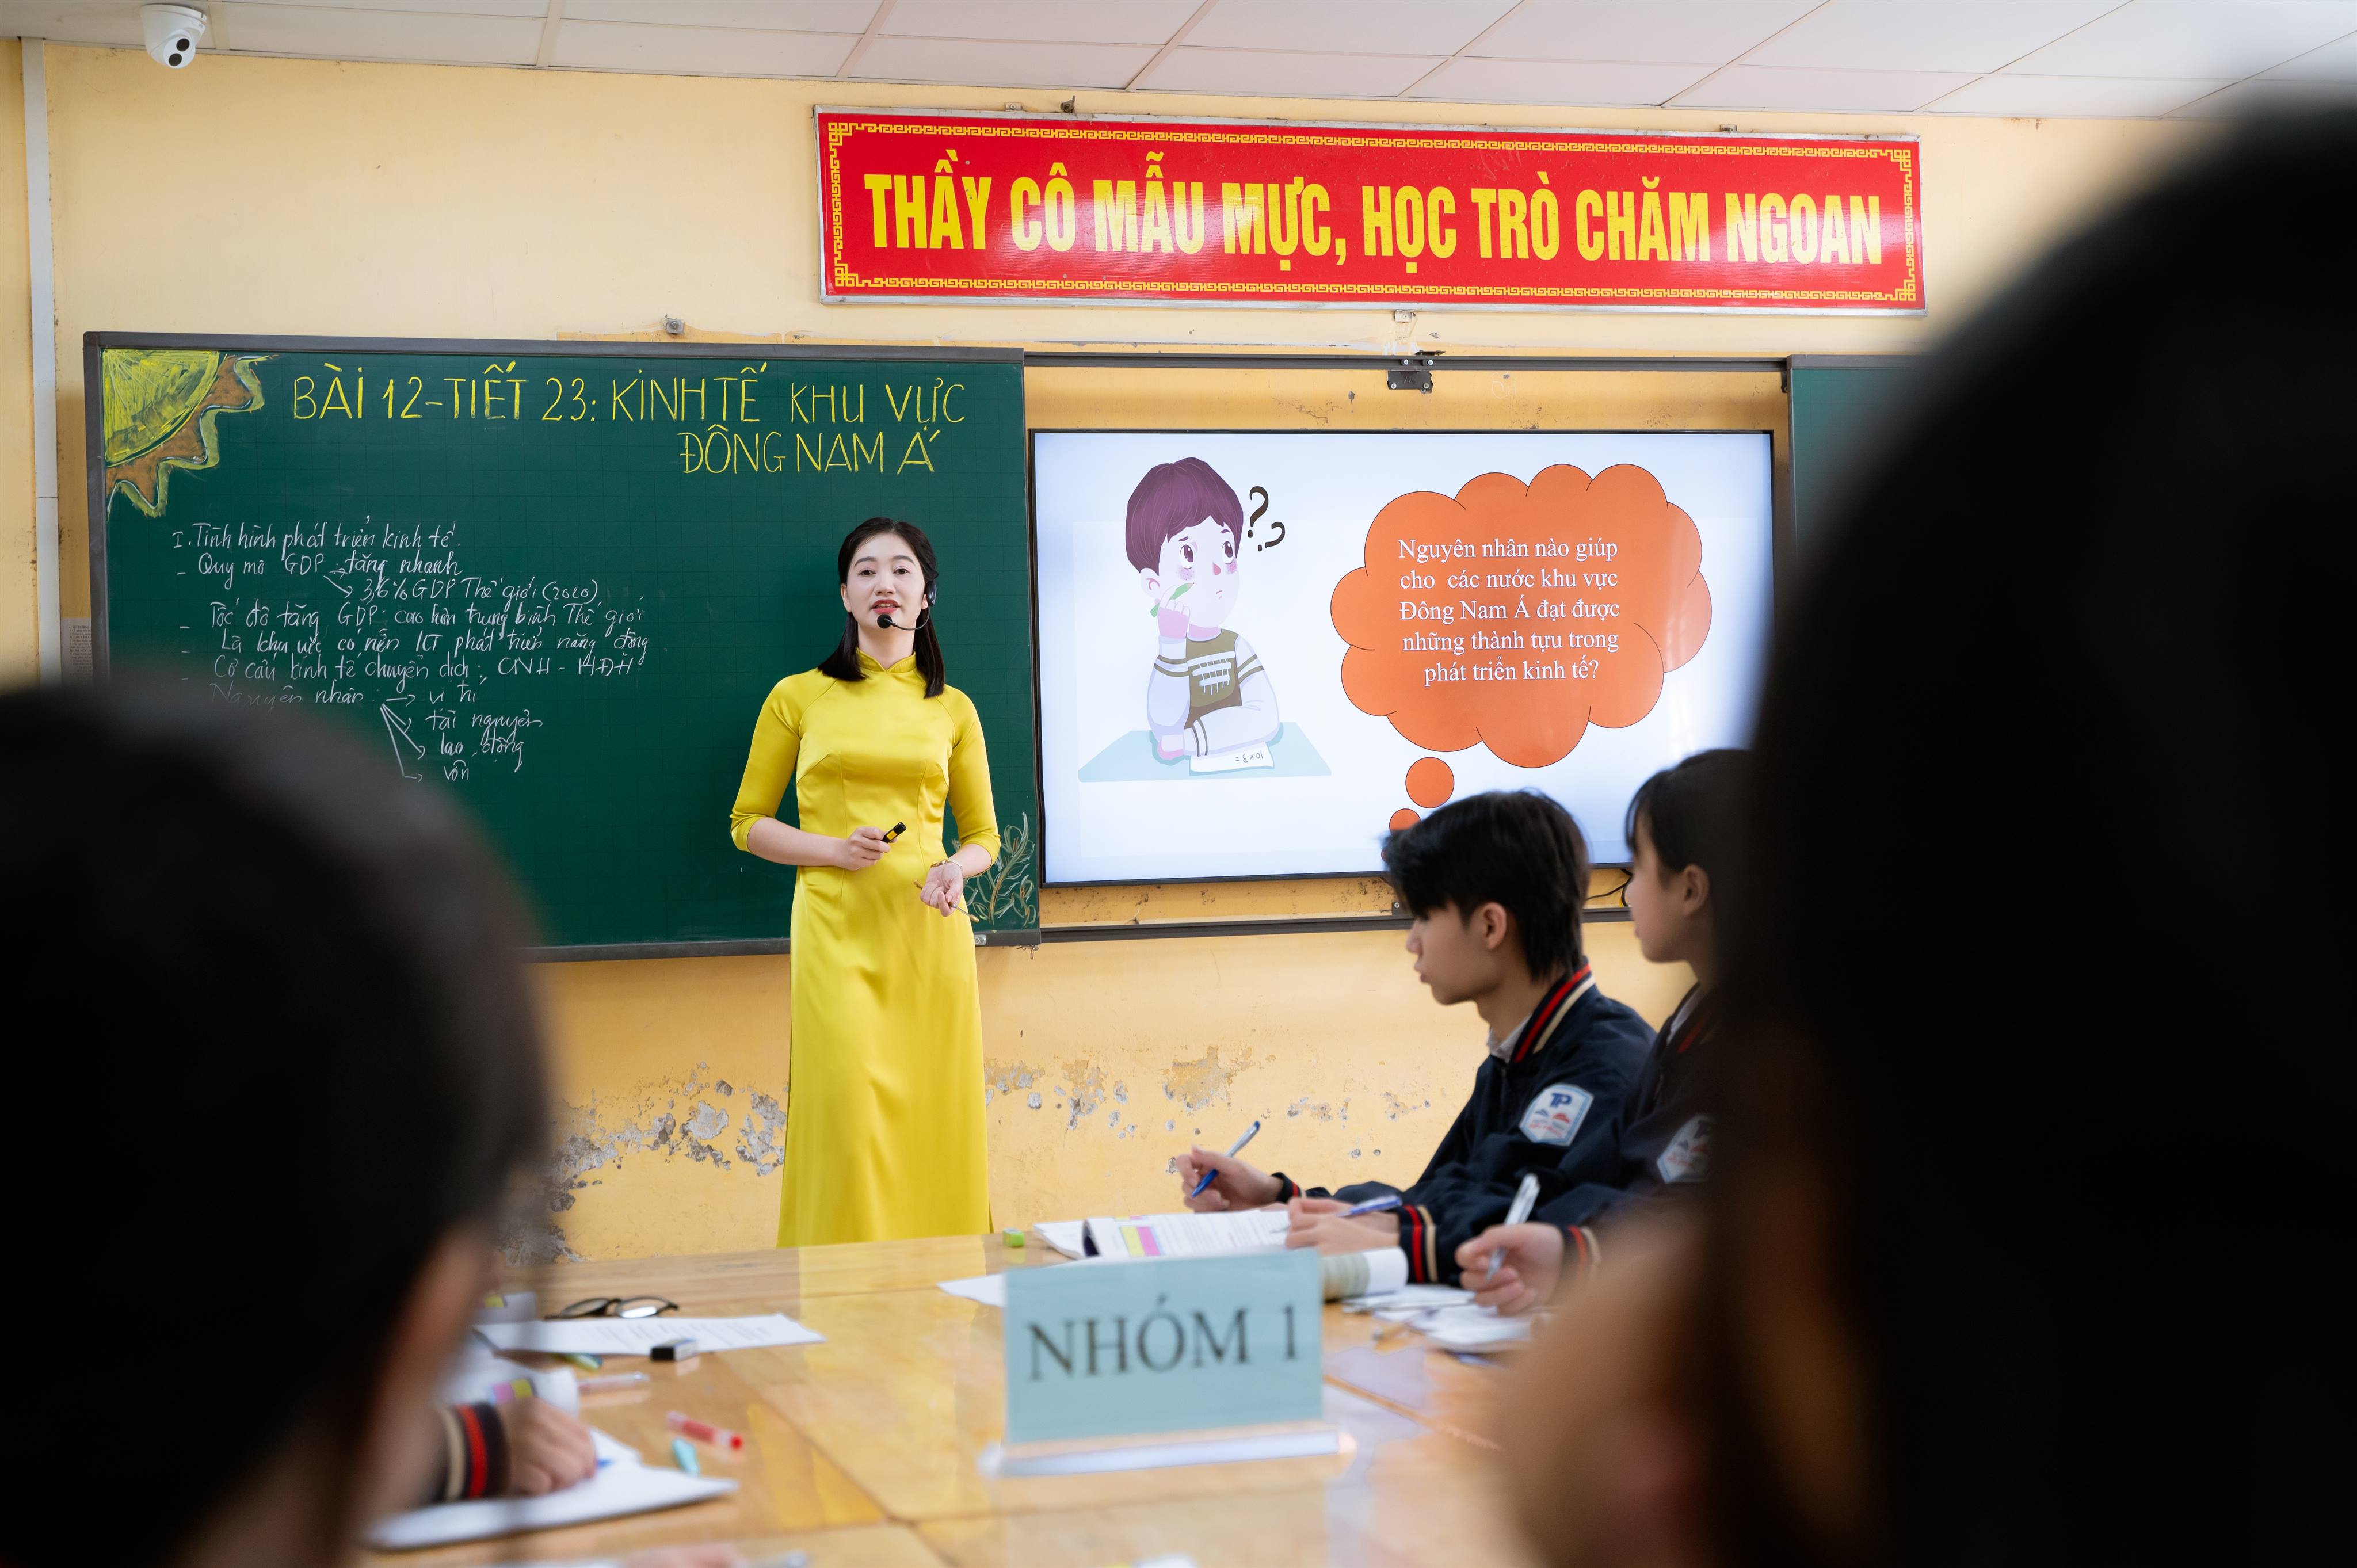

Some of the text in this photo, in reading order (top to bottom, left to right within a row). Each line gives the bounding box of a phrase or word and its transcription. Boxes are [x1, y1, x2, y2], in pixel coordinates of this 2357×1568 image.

[864, 149, 1882, 273] THẦY CÔ MẪU MỰC, HỌC TRÒ CHĂM NGOAN
[293, 363, 363, 419] BÀI
[542, 377, 596, 421] 23:
[612, 369, 705, 421] KINH
[714, 362, 767, 422] TẾ
[792, 382, 863, 423] KHU
[885, 377, 965, 430] VỰC
[677, 424, 941, 474] ĐÔNG NAM Á
[192, 523, 231, 548] Tình
[238, 522, 276, 549] hình
[281, 520, 327, 560] phát
[334, 515, 375, 548] triển
[382, 523, 423, 549] kinh
[1398, 537, 1618, 563] Nguyên nhân nào giúp
[198, 552, 234, 590] Quy
[243, 560, 265, 575] mô
[345, 550, 388, 591] tăng
[399, 549, 463, 575] nhanh
[1400, 569, 1618, 590] cho các nước khu vực
[412, 579, 456, 600] GDP
[460, 577, 504, 598] Thế
[502, 576, 536, 612] giới
[542, 579, 598, 604] (2020)
[1399, 594, 1620, 624] Đông Nam Á đạt được
[210, 598, 239, 628] Tốc
[277, 601, 319, 643] tăng
[395, 610, 424, 624] cao
[465, 602, 509, 640] trung
[515, 601, 556, 626] bình
[563, 601, 603, 625] Thế
[605, 596, 645, 638] giới
[222, 628, 242, 653] Là
[257, 630, 288, 653] khu
[337, 628, 361, 651] có
[454, 627, 494, 658] phát
[506, 626, 543, 650] triển
[557, 633, 596, 666] năng
[1402, 630, 1619, 655] những thành tựu trong
[215, 654, 238, 677] Cơ
[245, 652, 276, 681] cấu
[291, 653, 327, 680] kinh
[335, 652, 362, 679] tế
[365, 653, 428, 693] chuyển
[498, 657, 550, 676] CNH
[1424, 654, 1599, 686] phát triển kinh tế?
[426, 709, 543, 745] tài nguyên
[441, 732, 463, 756] lao
[1028, 1294, 1298, 1382] NHÓM 1
